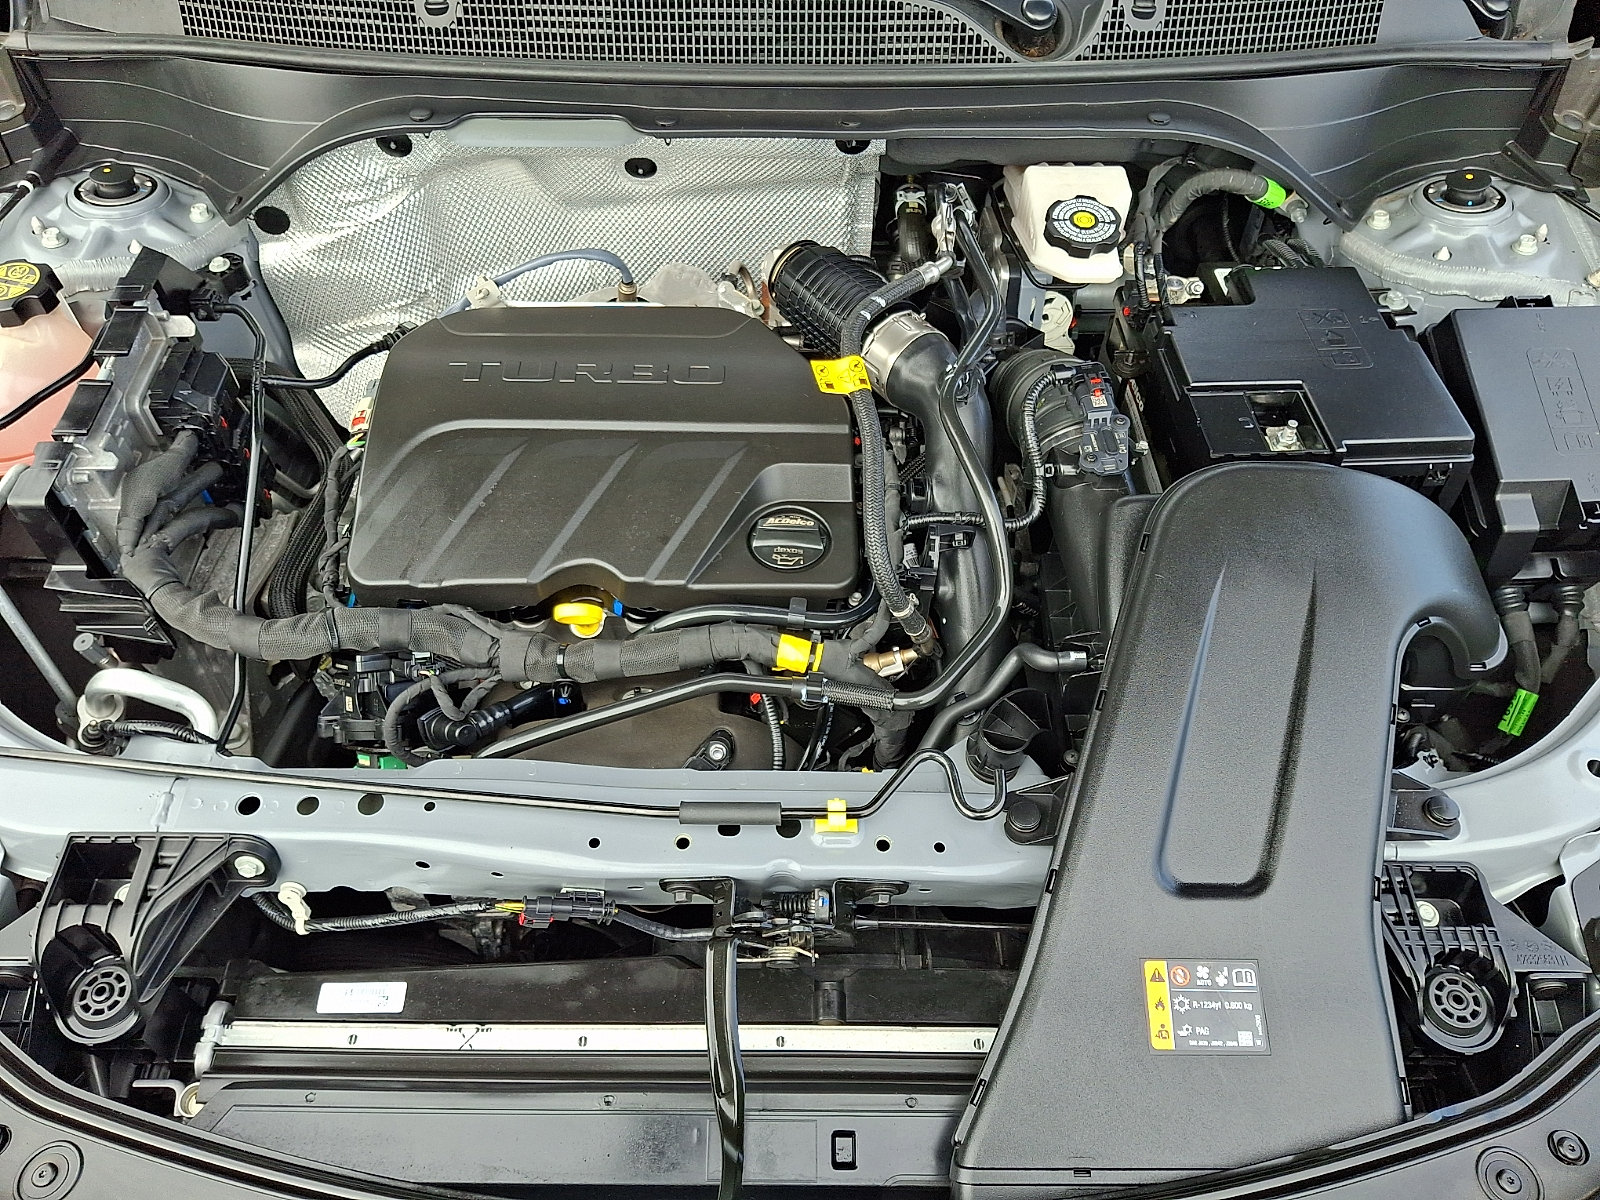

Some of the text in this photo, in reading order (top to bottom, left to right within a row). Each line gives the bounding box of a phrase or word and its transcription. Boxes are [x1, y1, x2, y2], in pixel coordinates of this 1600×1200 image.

[449, 361, 726, 385] TURBO
[763, 517, 815, 527] ACDelco
[773, 546, 804, 555] dexos
[1195, 1027, 1210, 1036] PAG
